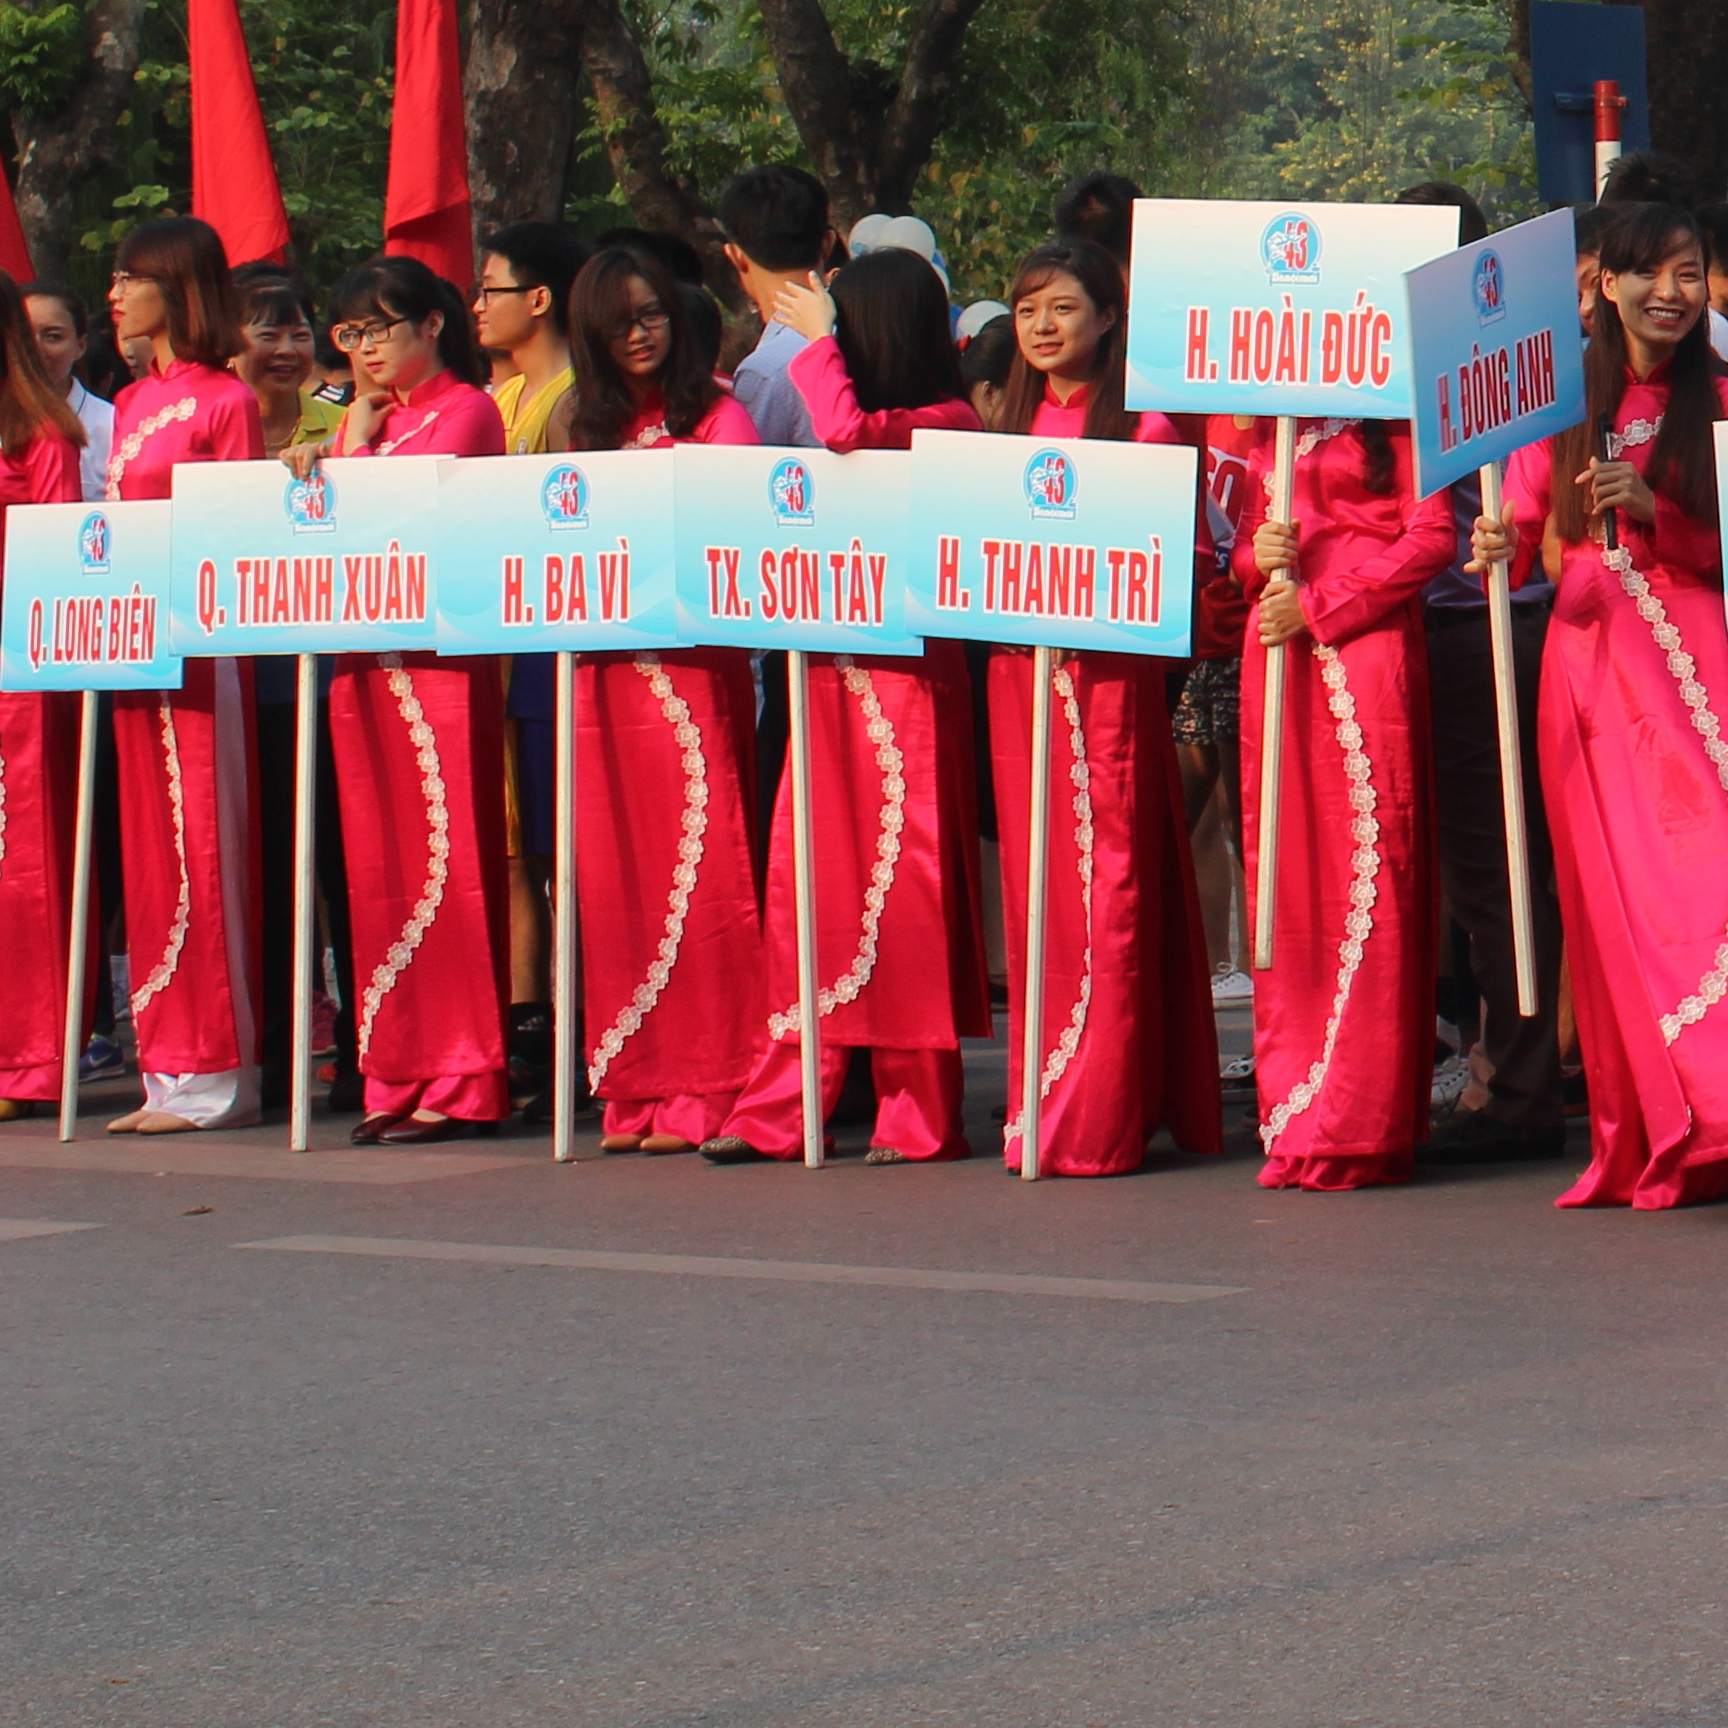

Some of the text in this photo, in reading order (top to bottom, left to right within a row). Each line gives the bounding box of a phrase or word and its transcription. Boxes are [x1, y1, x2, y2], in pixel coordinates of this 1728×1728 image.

[1185, 290, 1393, 388] H. HOÀI ĐỨC
[1514, 327, 1558, 419] ANH
[28, 580, 158, 671] Q. LONG BIÊN
[197, 540, 428, 634] Q. THANH XUÂN
[502, 537, 631, 625] H. BA VÌ
[705, 537, 888, 625] TX. SƠN TÂY
[936, 535, 1164, 625] H. THANH TRÌ
